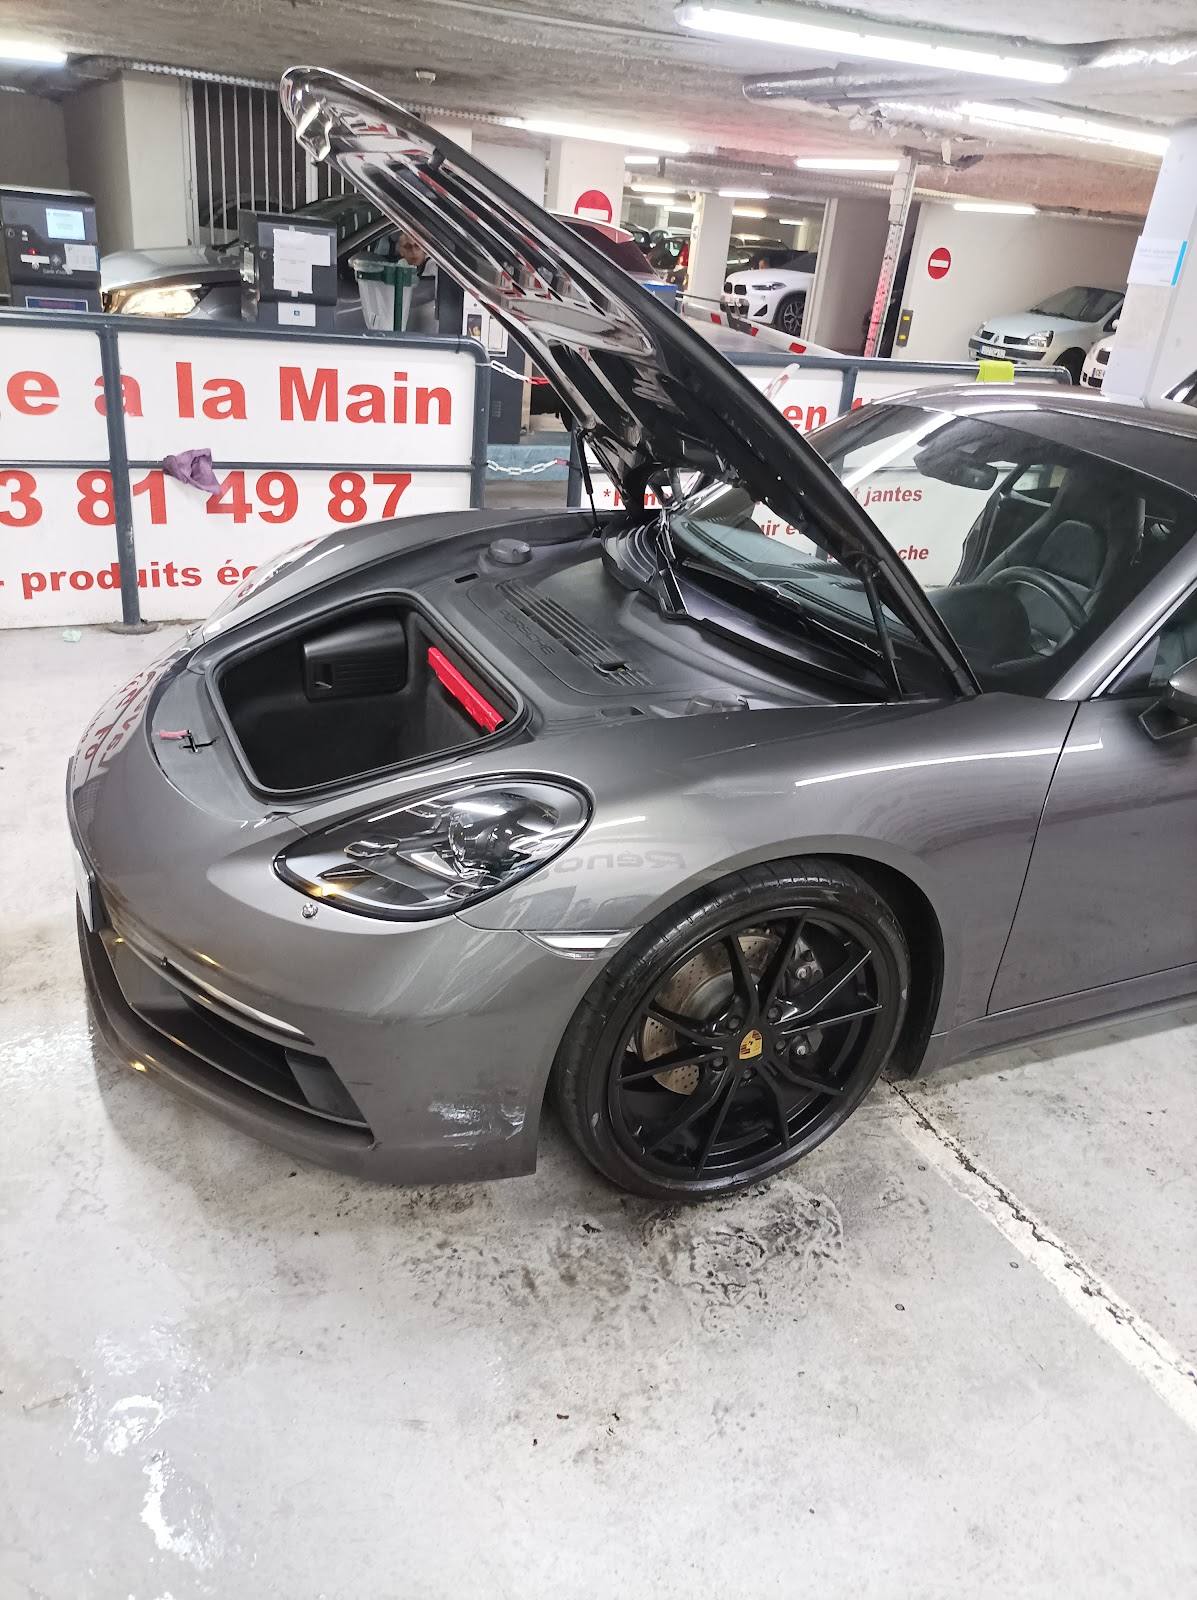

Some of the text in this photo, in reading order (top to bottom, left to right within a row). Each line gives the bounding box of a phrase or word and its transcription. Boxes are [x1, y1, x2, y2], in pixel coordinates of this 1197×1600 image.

[175, 361, 248, 420] la
[279, 366, 452, 425] Main
[0, 469, 412, 527] 3 81 49 87
[863, 486, 923, 507] jantes
[785, 524, 804, 535] e
[499, 609, 556, 656] PORSCHE
